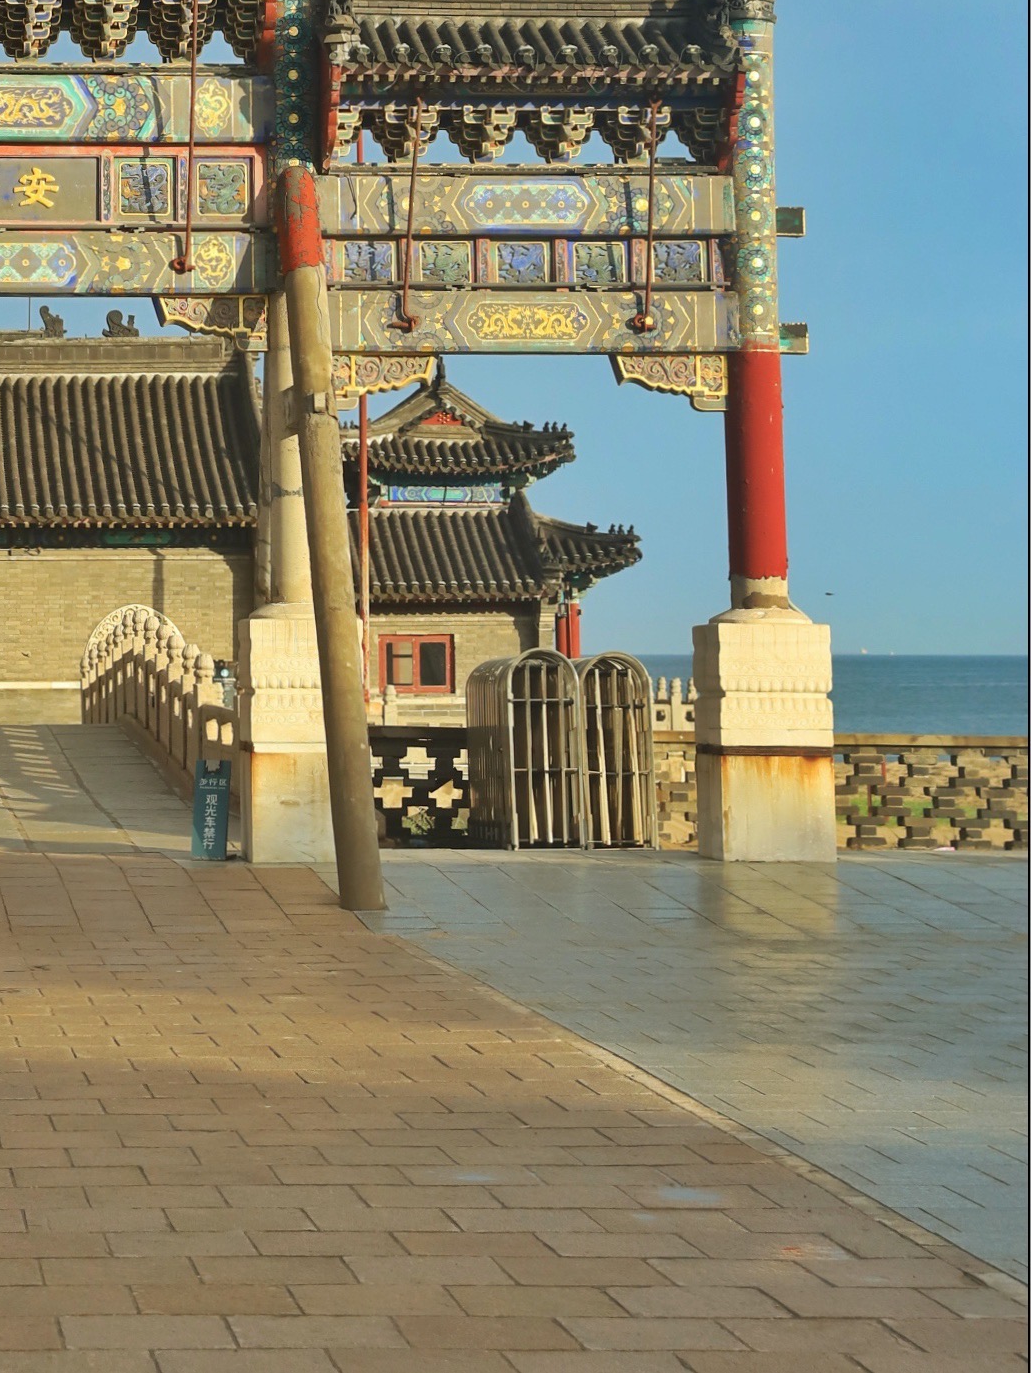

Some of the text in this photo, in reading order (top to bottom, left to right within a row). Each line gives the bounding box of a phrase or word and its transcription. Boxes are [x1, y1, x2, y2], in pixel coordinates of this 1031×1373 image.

[203, 794, 218, 850] 观光车禁行
